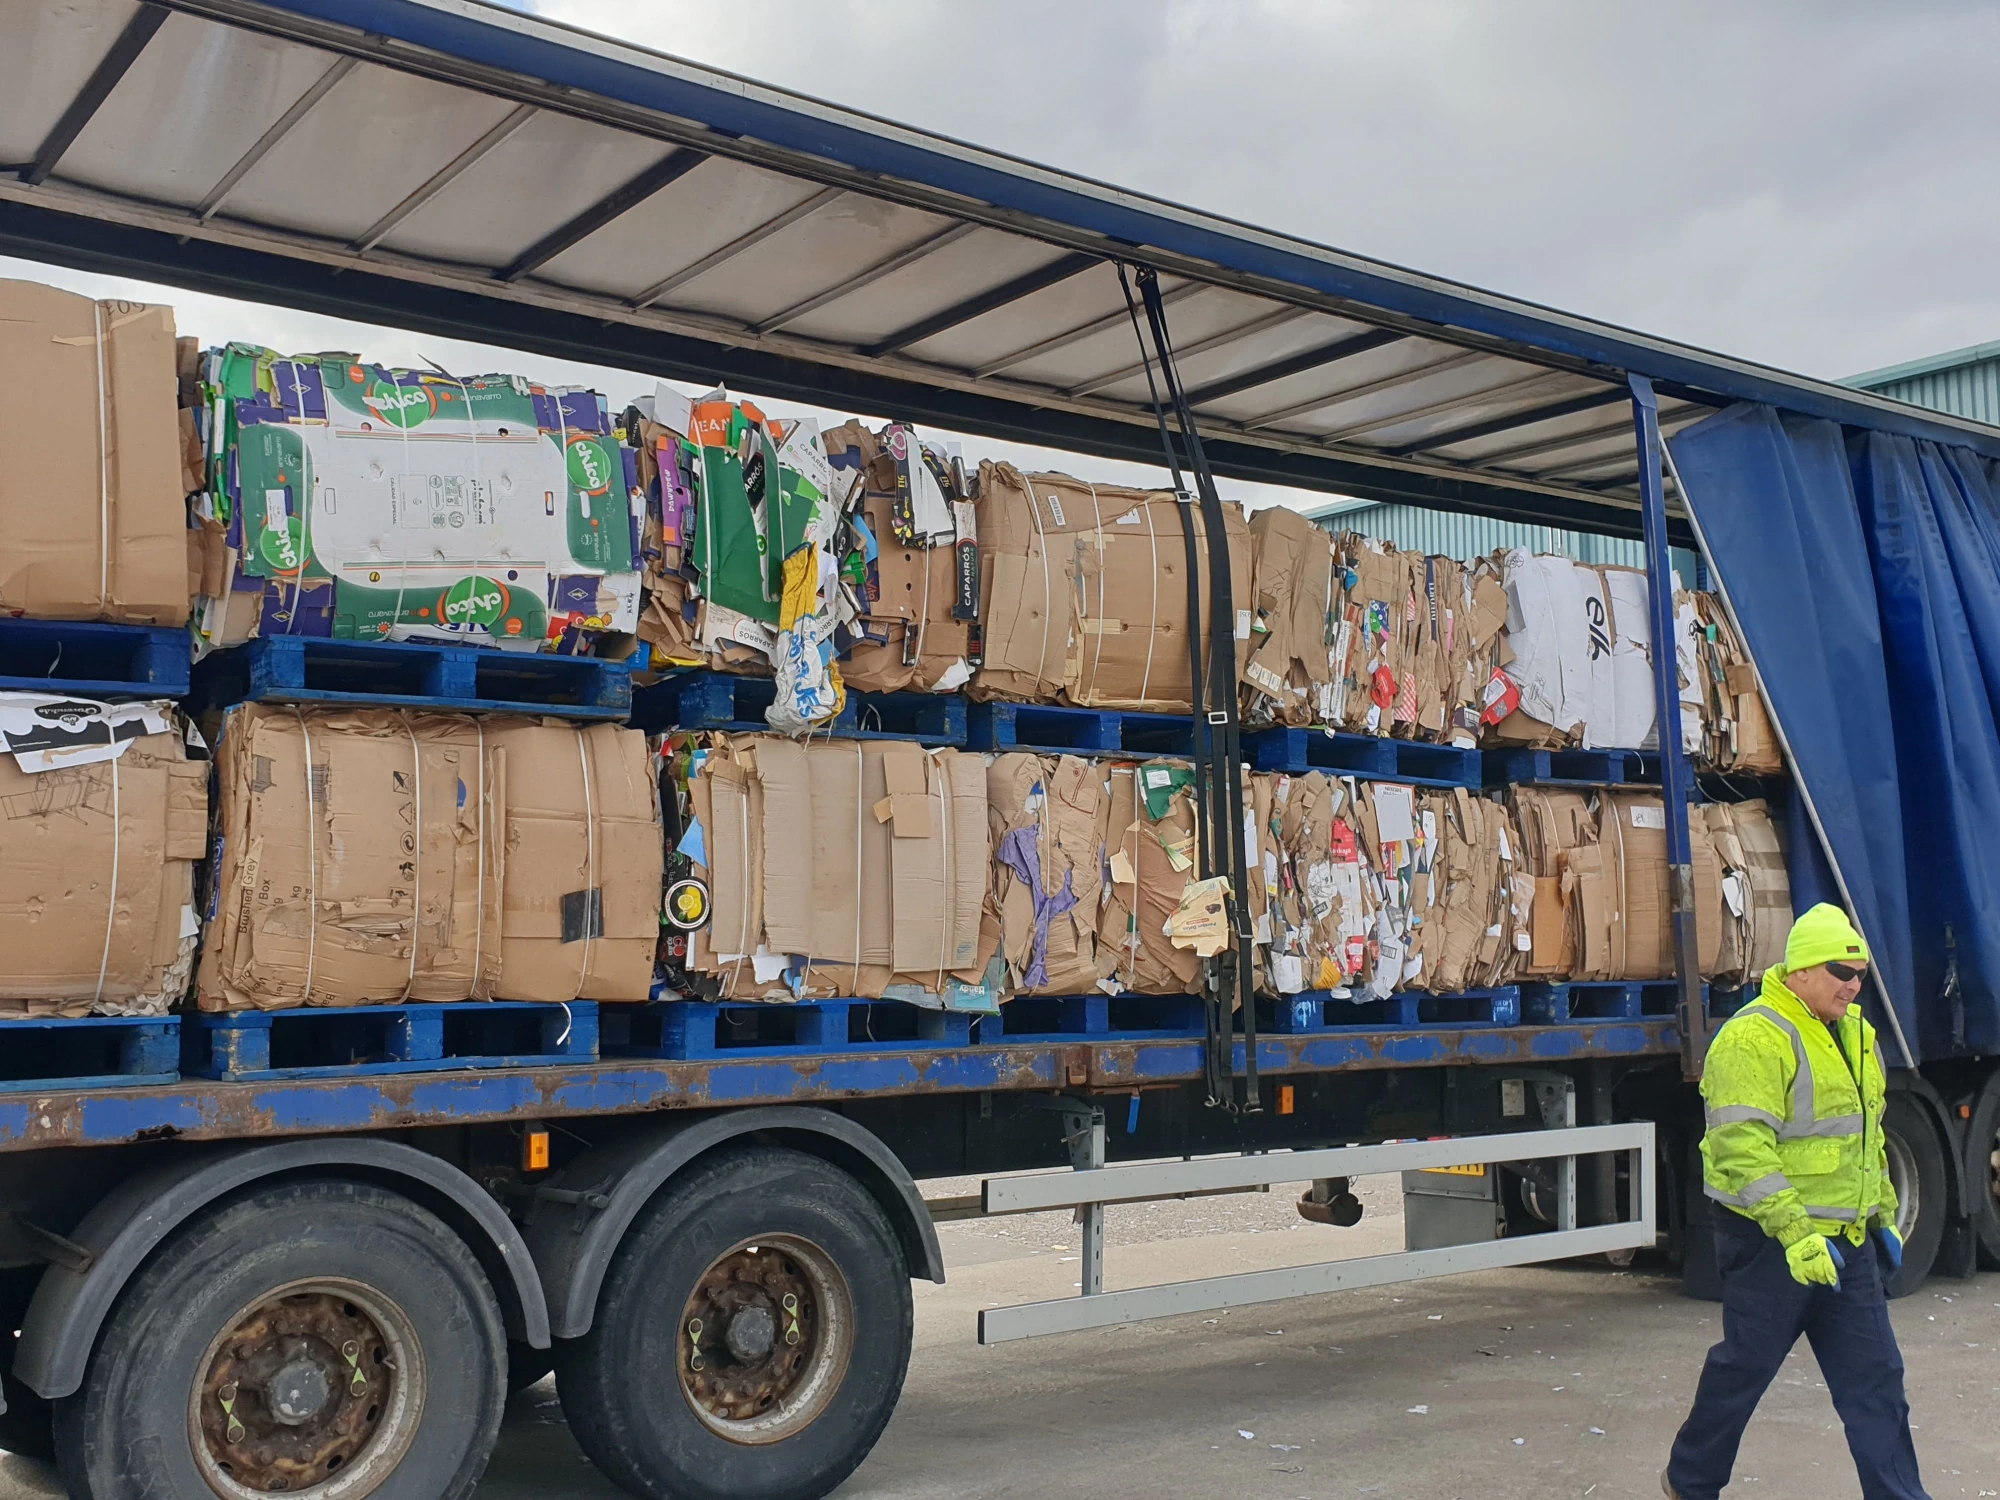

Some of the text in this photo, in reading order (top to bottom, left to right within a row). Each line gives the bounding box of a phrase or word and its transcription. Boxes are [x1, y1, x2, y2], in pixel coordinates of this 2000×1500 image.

[575, 441, 600, 488] chico
[961, 546, 971, 606] CAPARRÓS
[446, 591, 503, 616] chico
[738, 630, 775, 650] CAPARRÓS
[1585, 596, 1611, 661] elk
[238, 857, 258, 934] Brushed Grey
[258, 879, 271, 900] Box
[290, 885, 302, 898] kg
